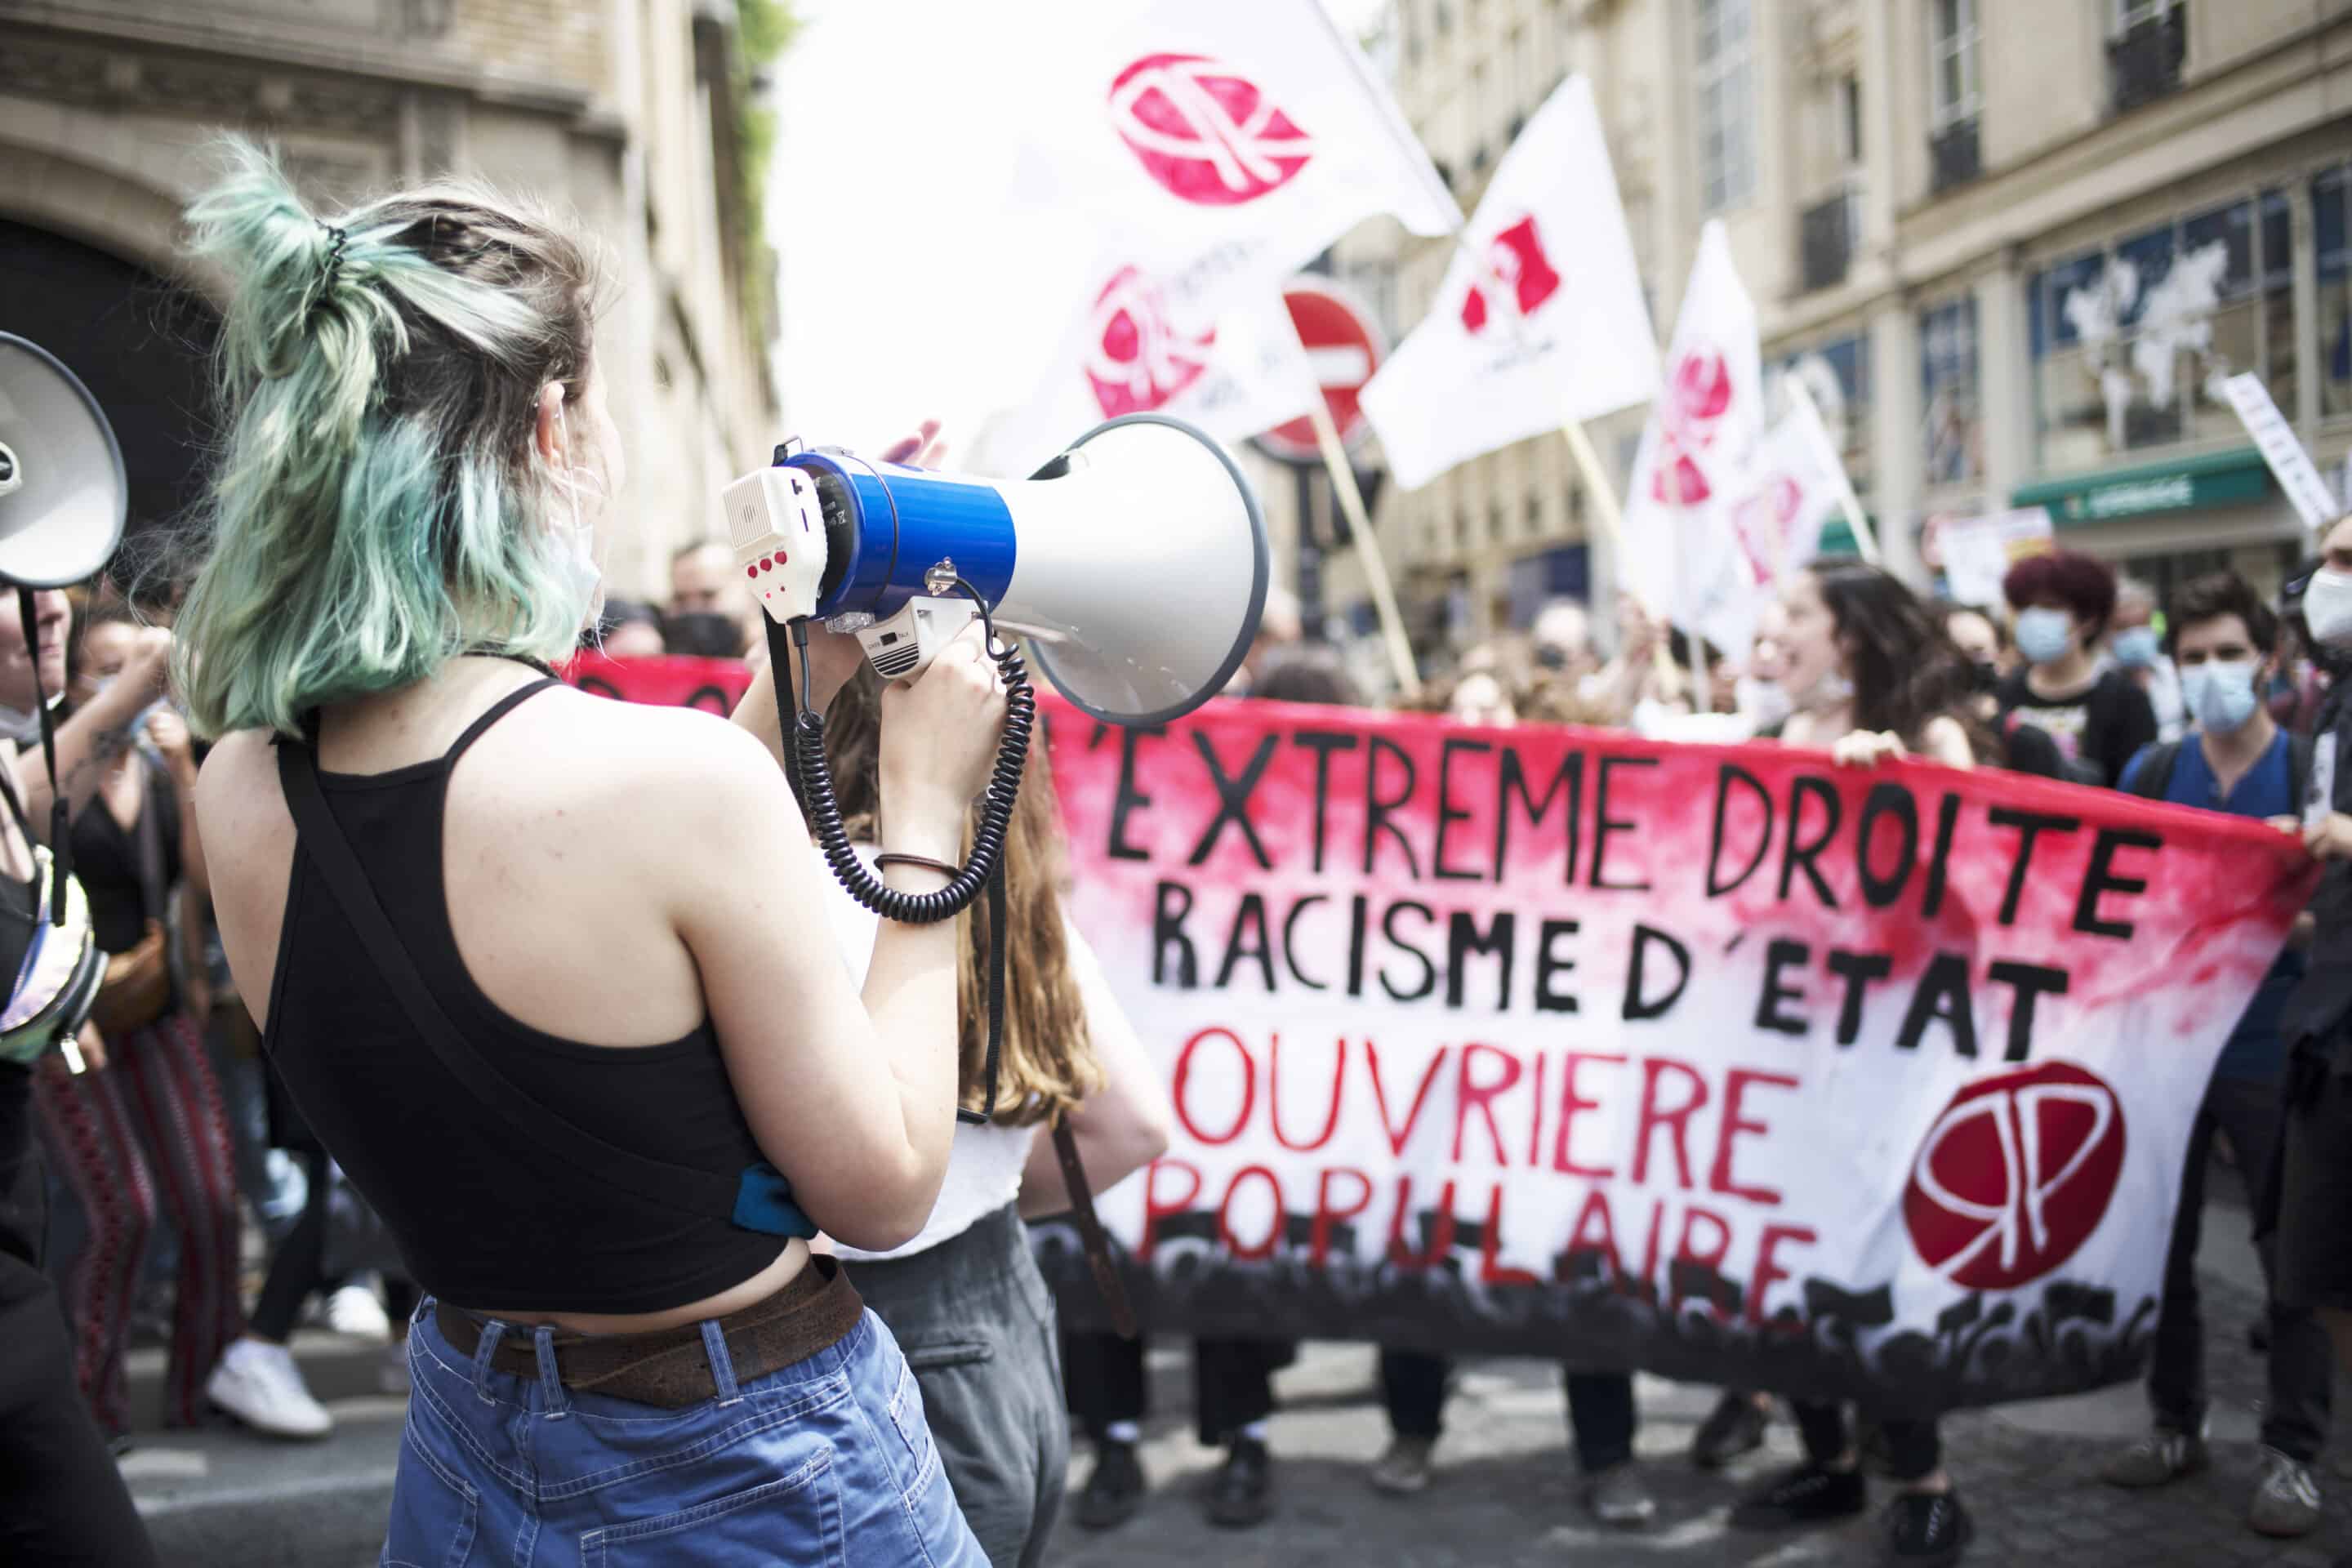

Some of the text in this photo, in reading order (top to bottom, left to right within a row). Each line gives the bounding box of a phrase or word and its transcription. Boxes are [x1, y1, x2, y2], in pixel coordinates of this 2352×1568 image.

[1706, 764, 2164, 940] DROITE
[1152, 881, 1579, 1012] RACISME
[1174, 1027, 1801, 1205] OUVRIERE
[1136, 1158, 1817, 1334] POPULAIRE
